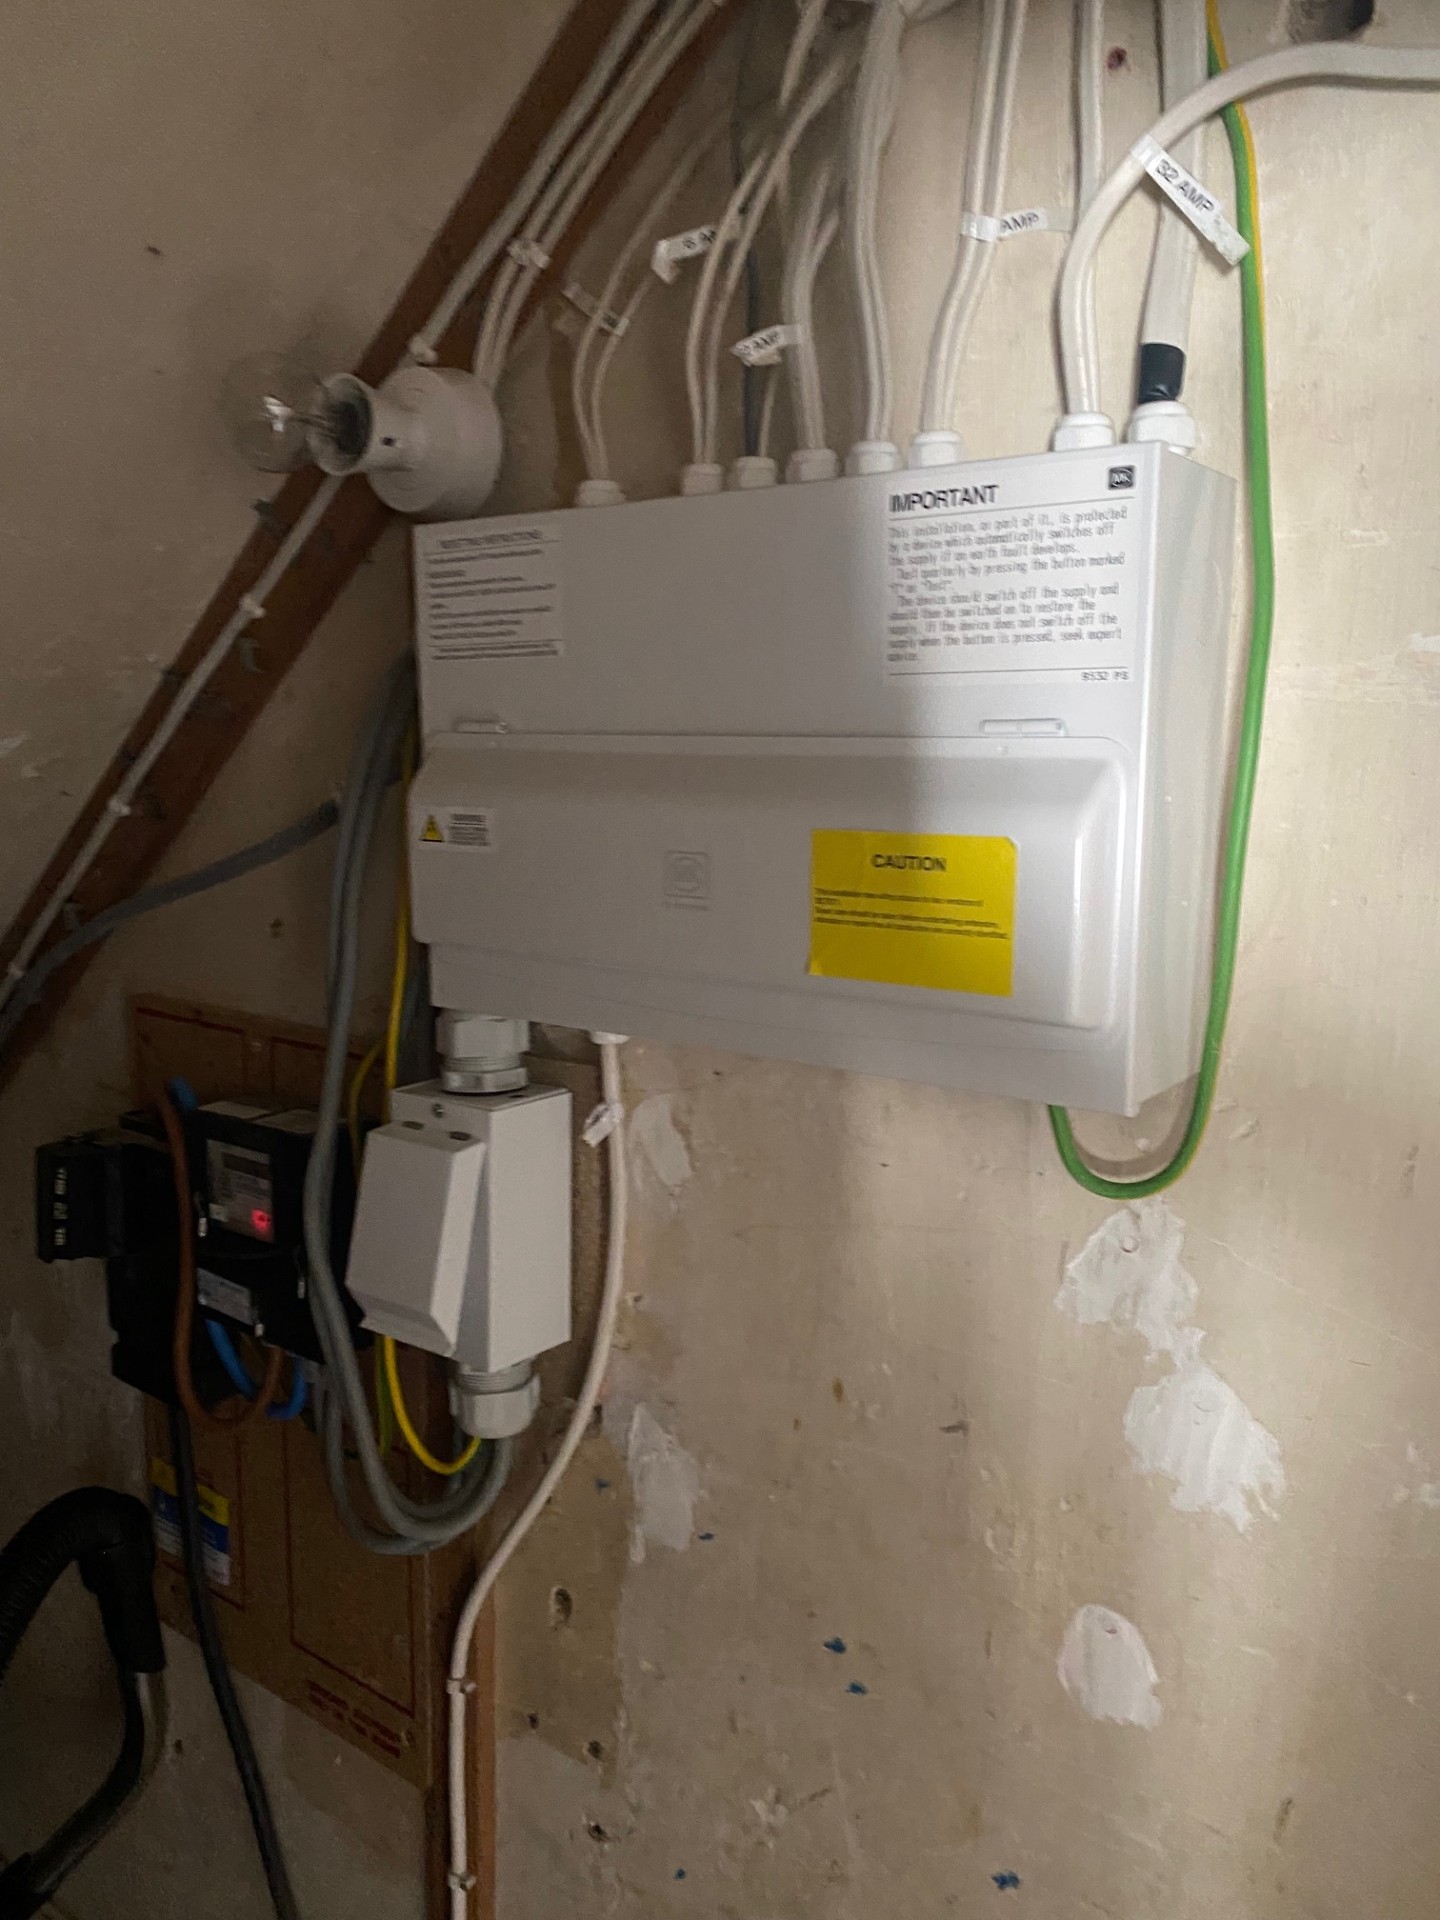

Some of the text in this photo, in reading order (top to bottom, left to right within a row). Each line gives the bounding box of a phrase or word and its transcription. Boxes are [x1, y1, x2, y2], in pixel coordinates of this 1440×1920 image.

[1155, 158, 1214, 212] 32 AMP
[890, 484, 999, 511] IMPORTANT
[1076, 506, 1127, 526] protected
[872, 854, 947, 871] CAUTION
